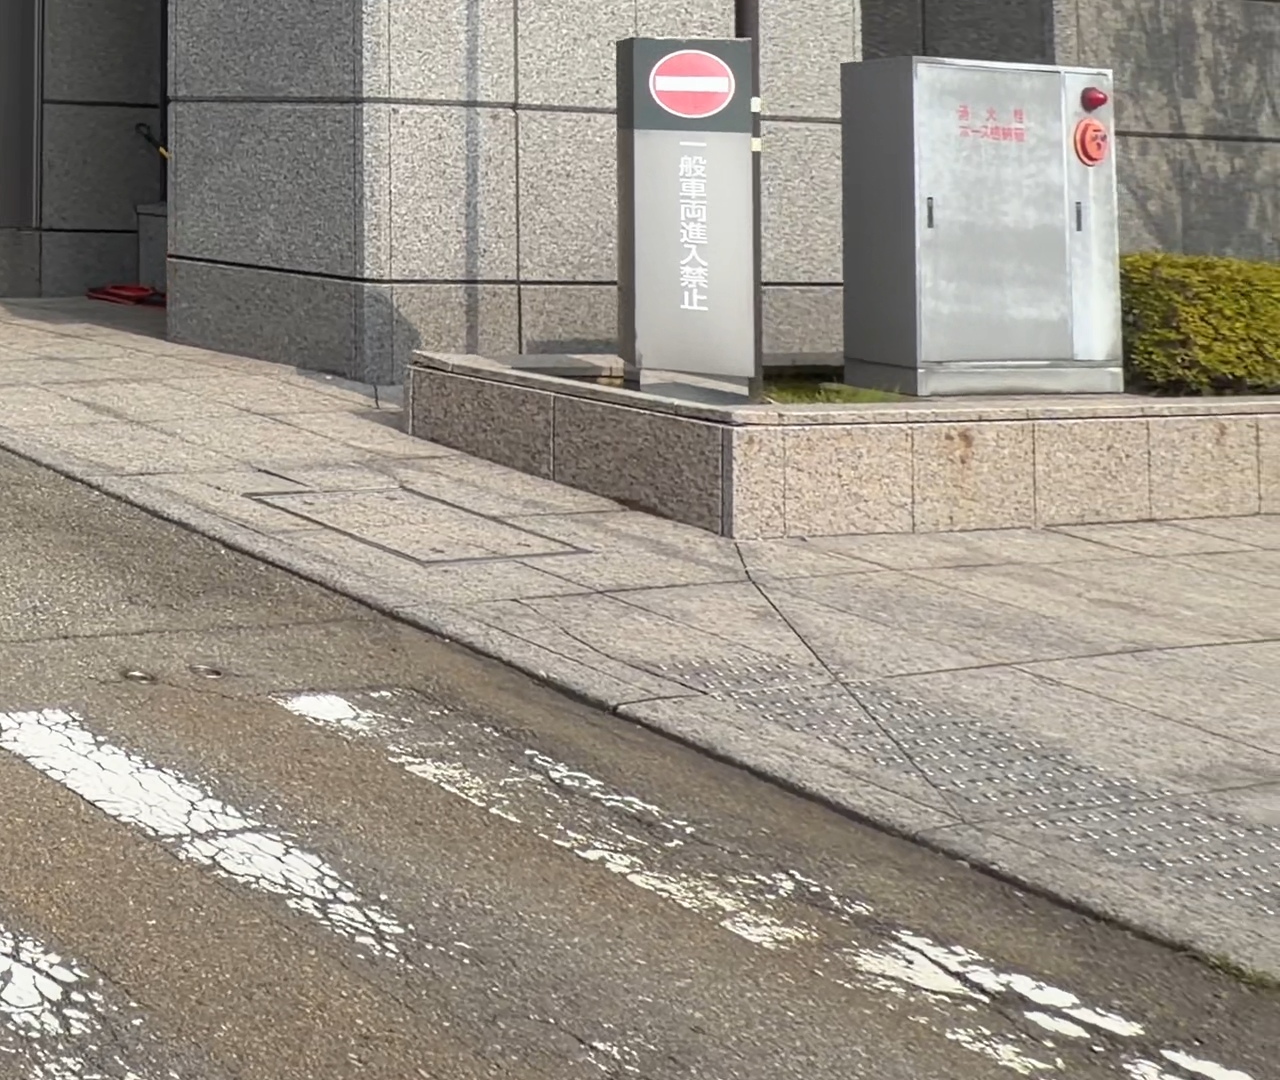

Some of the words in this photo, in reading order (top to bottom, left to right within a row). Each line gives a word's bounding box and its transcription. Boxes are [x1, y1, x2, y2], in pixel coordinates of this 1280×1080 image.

[678, 140, 709, 311] 一般車両進入禁止
